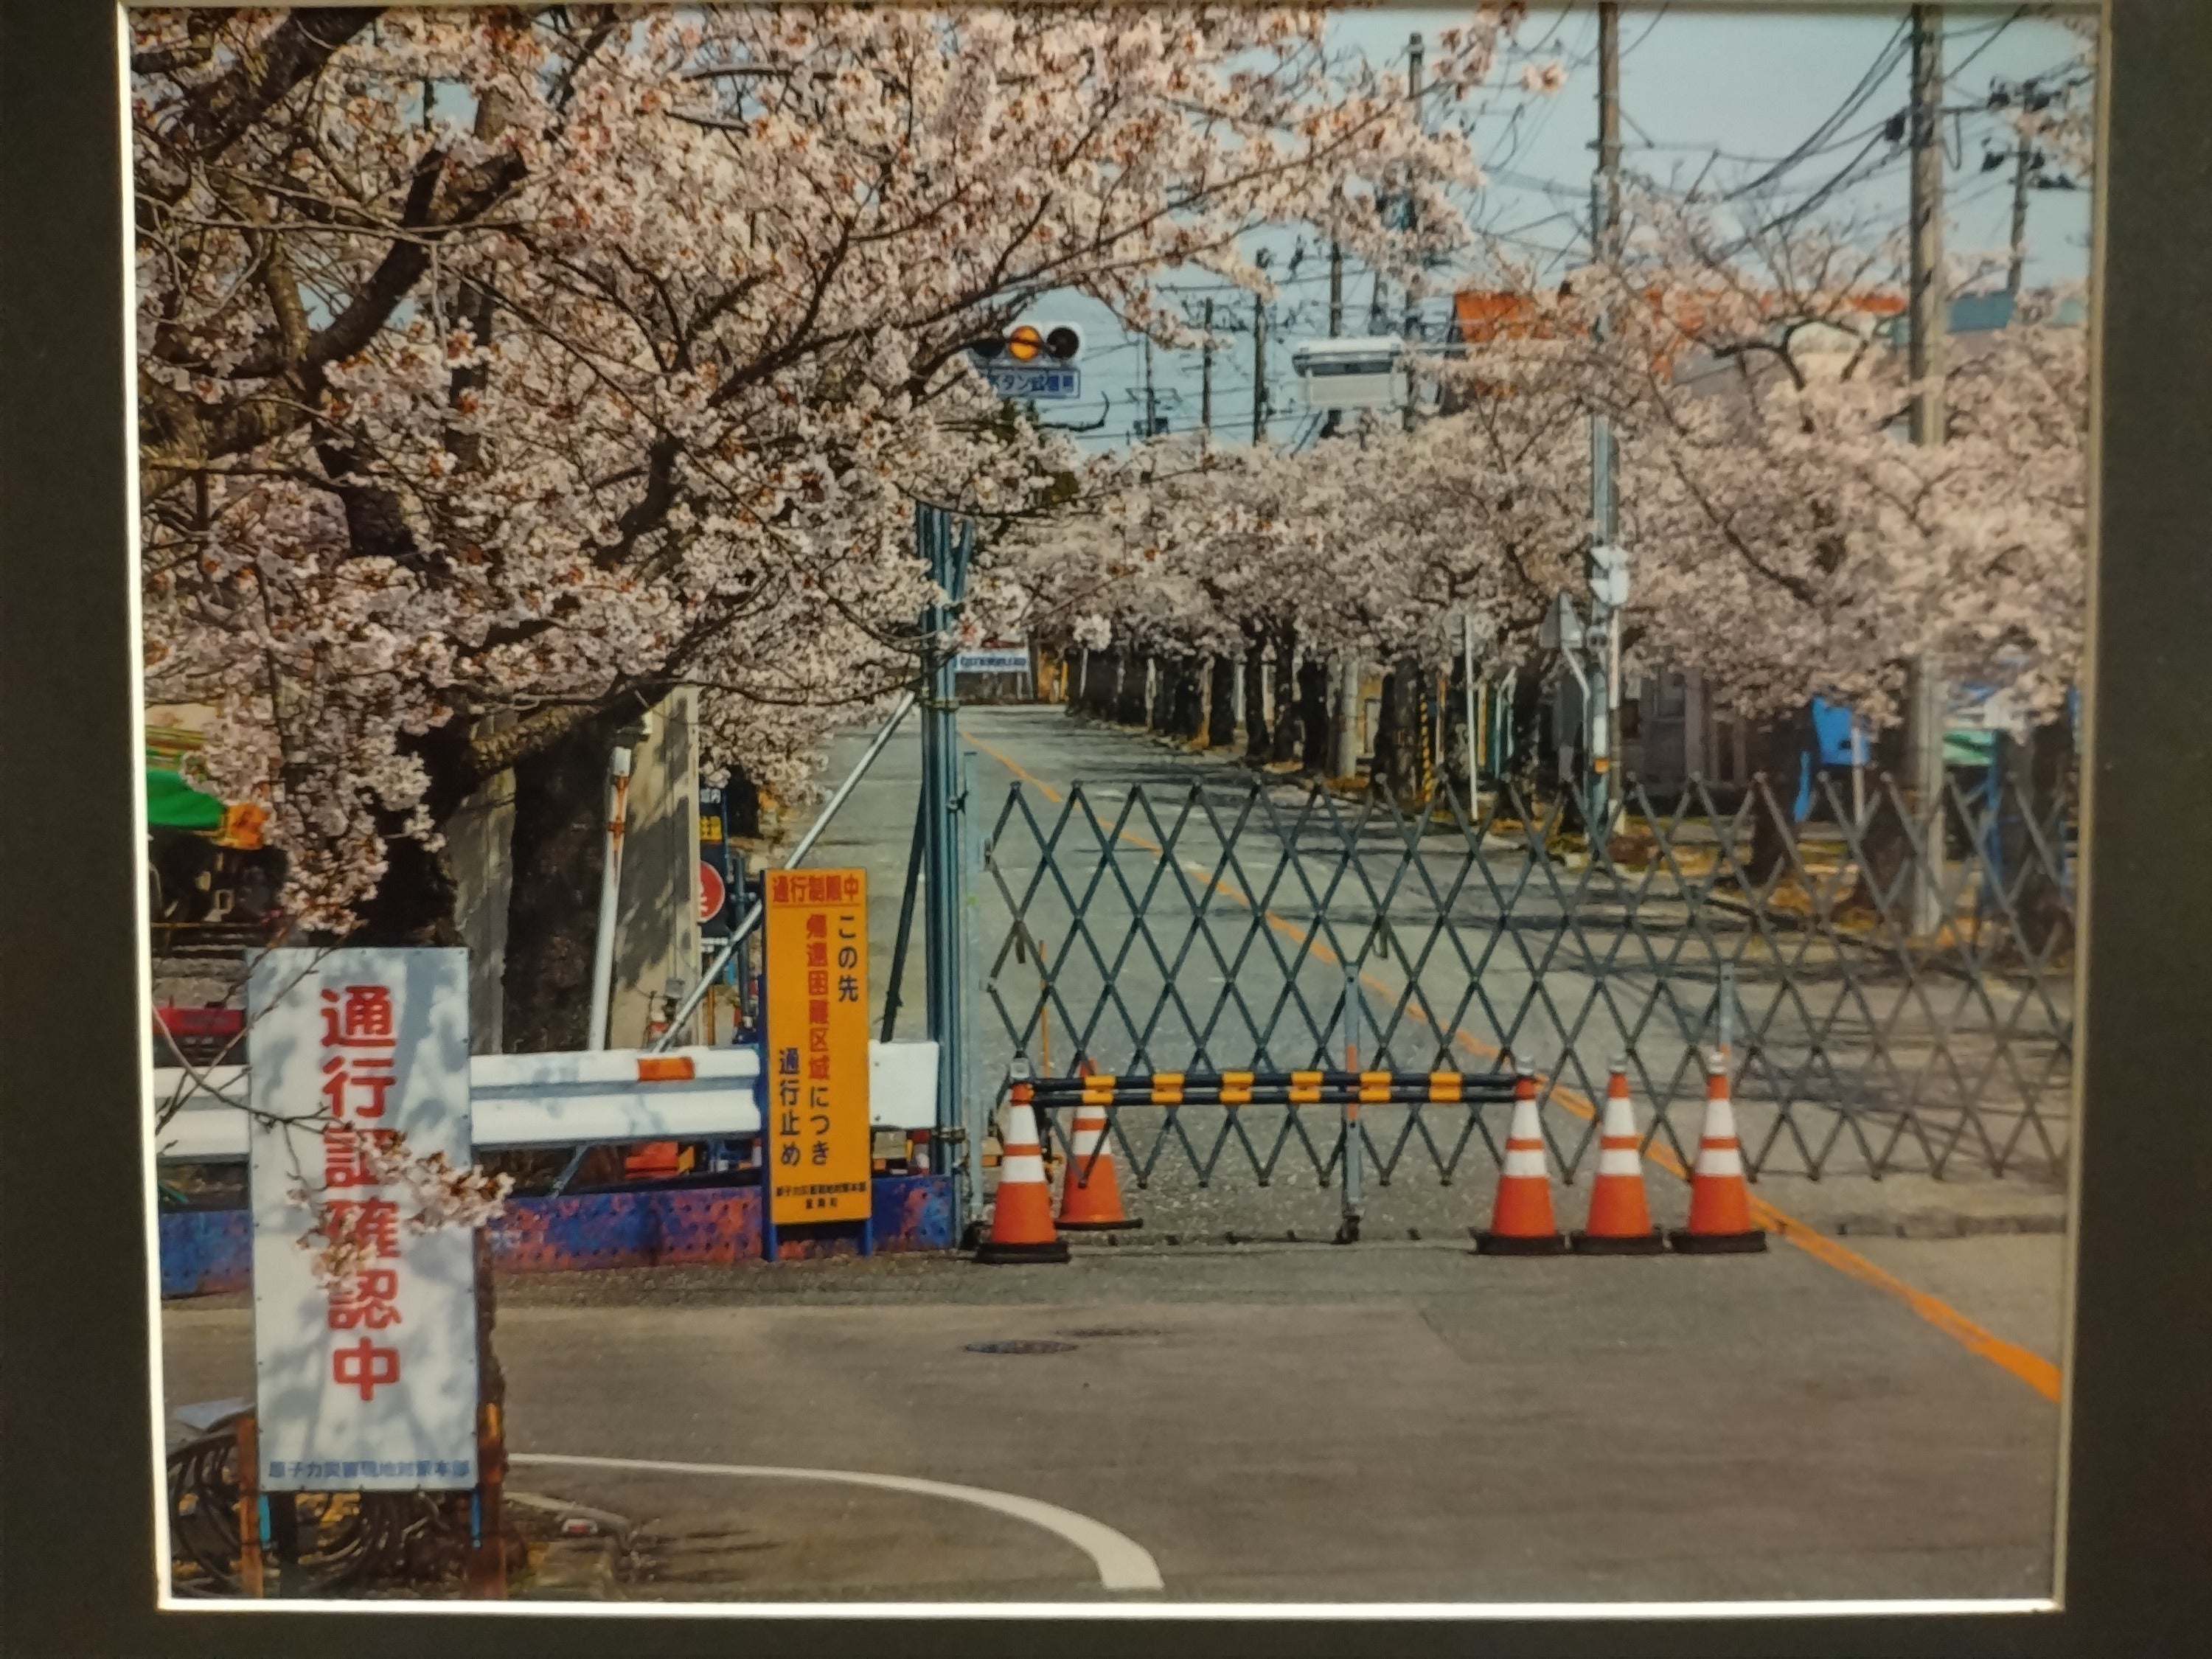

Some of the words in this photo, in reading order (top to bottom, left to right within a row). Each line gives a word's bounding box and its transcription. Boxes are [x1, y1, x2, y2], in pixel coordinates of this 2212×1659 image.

[838, 915, 859, 1003] この先
[806, 914, 831, 1166] 帰還困難区域につき
[779, 1047, 801, 1166] 通行止め
